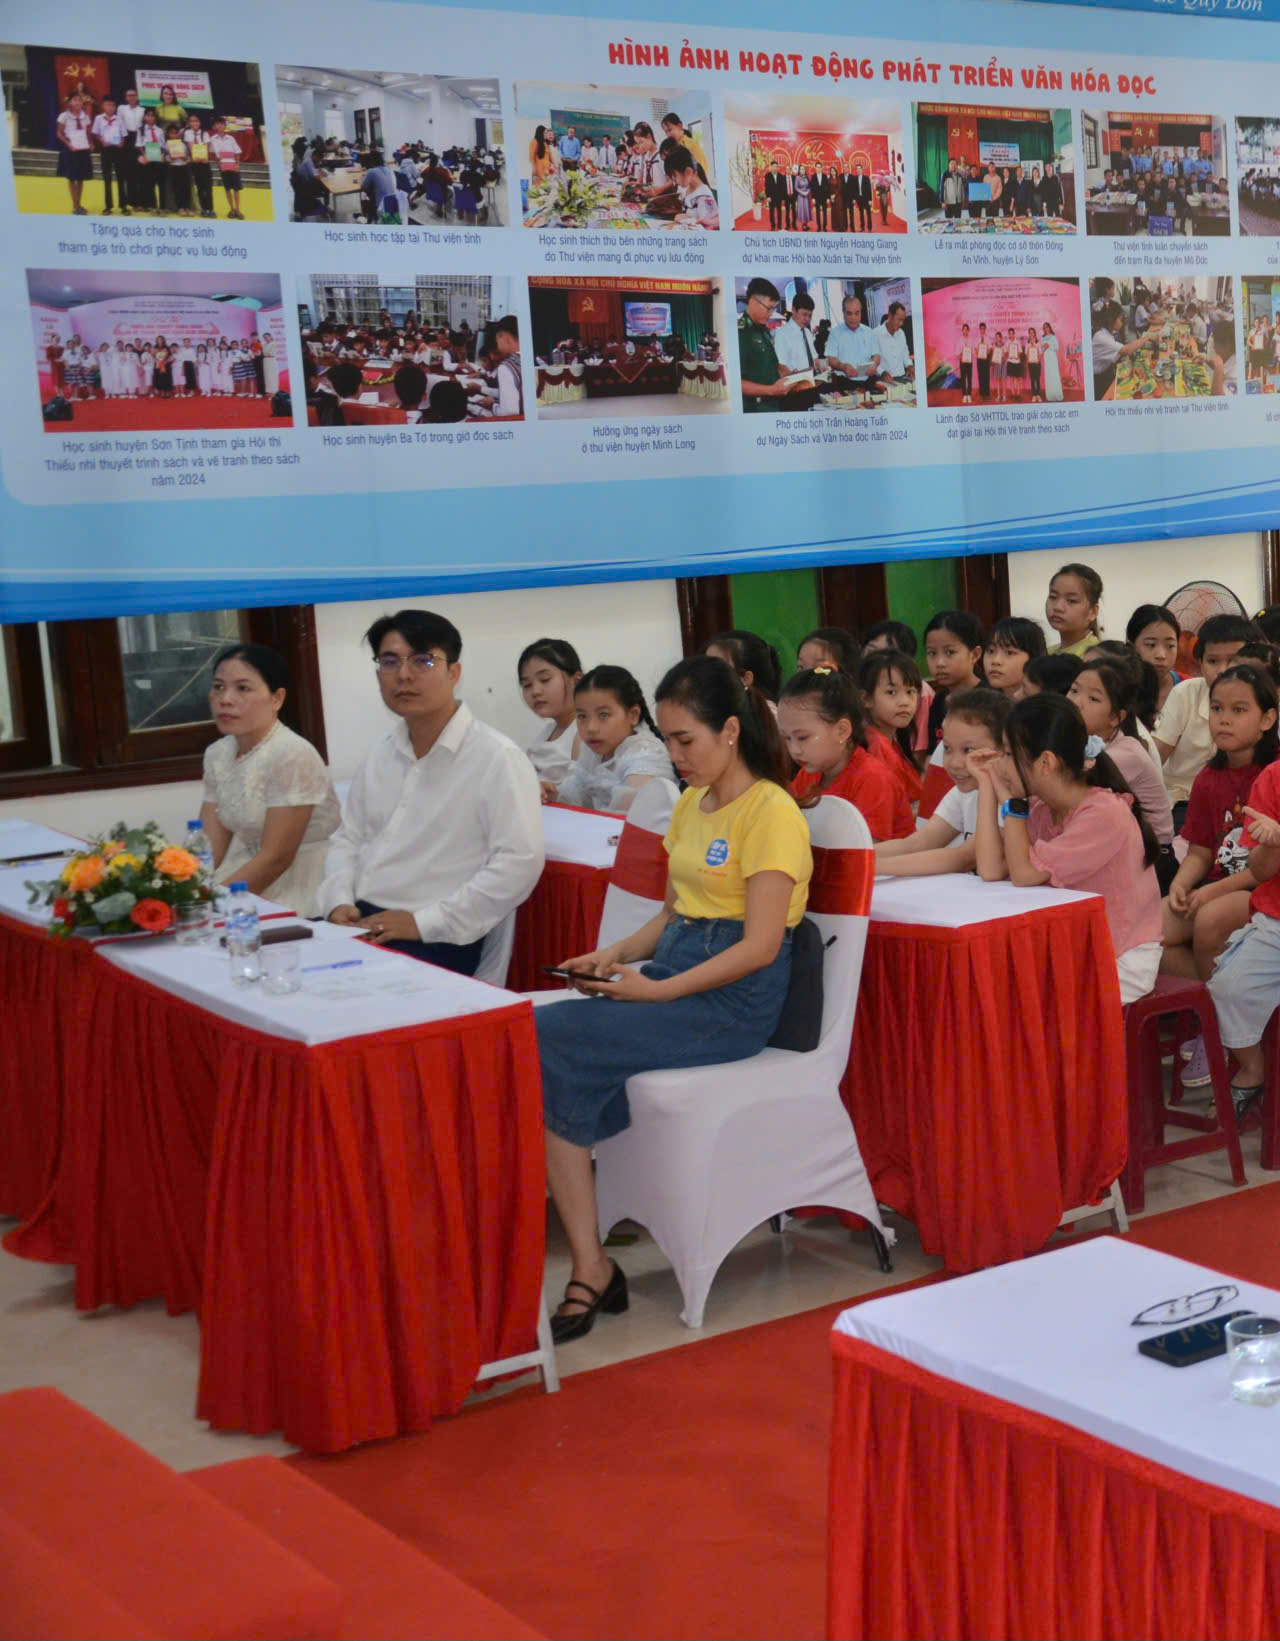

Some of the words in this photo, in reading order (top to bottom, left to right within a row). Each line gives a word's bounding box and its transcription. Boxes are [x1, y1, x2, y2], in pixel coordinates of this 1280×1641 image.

[608, 38, 669, 67] HÌNH
[680, 39, 729, 70] ẢNH
[740, 52, 802, 78] HOẠT
[812, 52, 874, 82] ĐỘNG
[883, 58, 941, 83] PHÁT
[950, 58, 1013, 87] TRIỂN
[1021, 66, 1062, 90] VĂN
[1071, 68, 1111, 92] HÓA
[1117, 75, 1156, 97] ĐỌC
[145, 226, 166, 237] cho
[192, 227, 215, 238] sinh
[346, 231, 368, 242] sinh
[538, 234, 557, 246] Học
[559, 235, 578, 245] sinh
[579, 235, 601, 246] thích
[602, 236, 617, 246] thú
[618, 236, 635, 246] bên
[636, 236, 663, 248] những
[664, 237, 687, 248] trang
[688, 237, 708, 247] sách
[778, 237, 802, 248] UBND
[876, 239, 898, 251] Giang
[57, 241, 88, 253] tham
[90, 242, 108, 256] gia
[544, 251, 557, 262] do
[559, 251, 576, 262] Thư
[577, 251, 595, 263] viện
[597, 253, 622, 264] mang
[623, 252, 632, 262] đi
[633, 253, 655, 264] phục
[656, 254, 667, 263] vụ
[668, 252, 682, 263] lưu
[683, 252, 705, 264] động
[592, 425, 621, 438] Hưởng
[622, 426, 639, 437] ứng
[640, 425, 661, 437] ngày
[663, 424, 683, 434] sách
[87, 440, 113, 452] sinh
[200, 438, 228, 449] tham
[230, 437, 246, 451] gia
[268, 436, 282, 447] thi
[345, 435, 367, 445] sinh
[399, 432, 413, 444] Ba
[429, 433, 454, 444] trong
[581, 442, 588, 454] ở
[589, 443, 604, 453] thư
[605, 442, 623, 453] viện
[624, 441, 651, 453] huyện
[652, 440, 673, 450] Minh
[674, 440, 696, 451] Long
[78, 459, 97, 470] nhi
[221, 454, 249, 466] tranh
[250, 455, 274, 465] theo
[151, 475, 176, 486] năm
[178, 473, 206, 485] 2024
